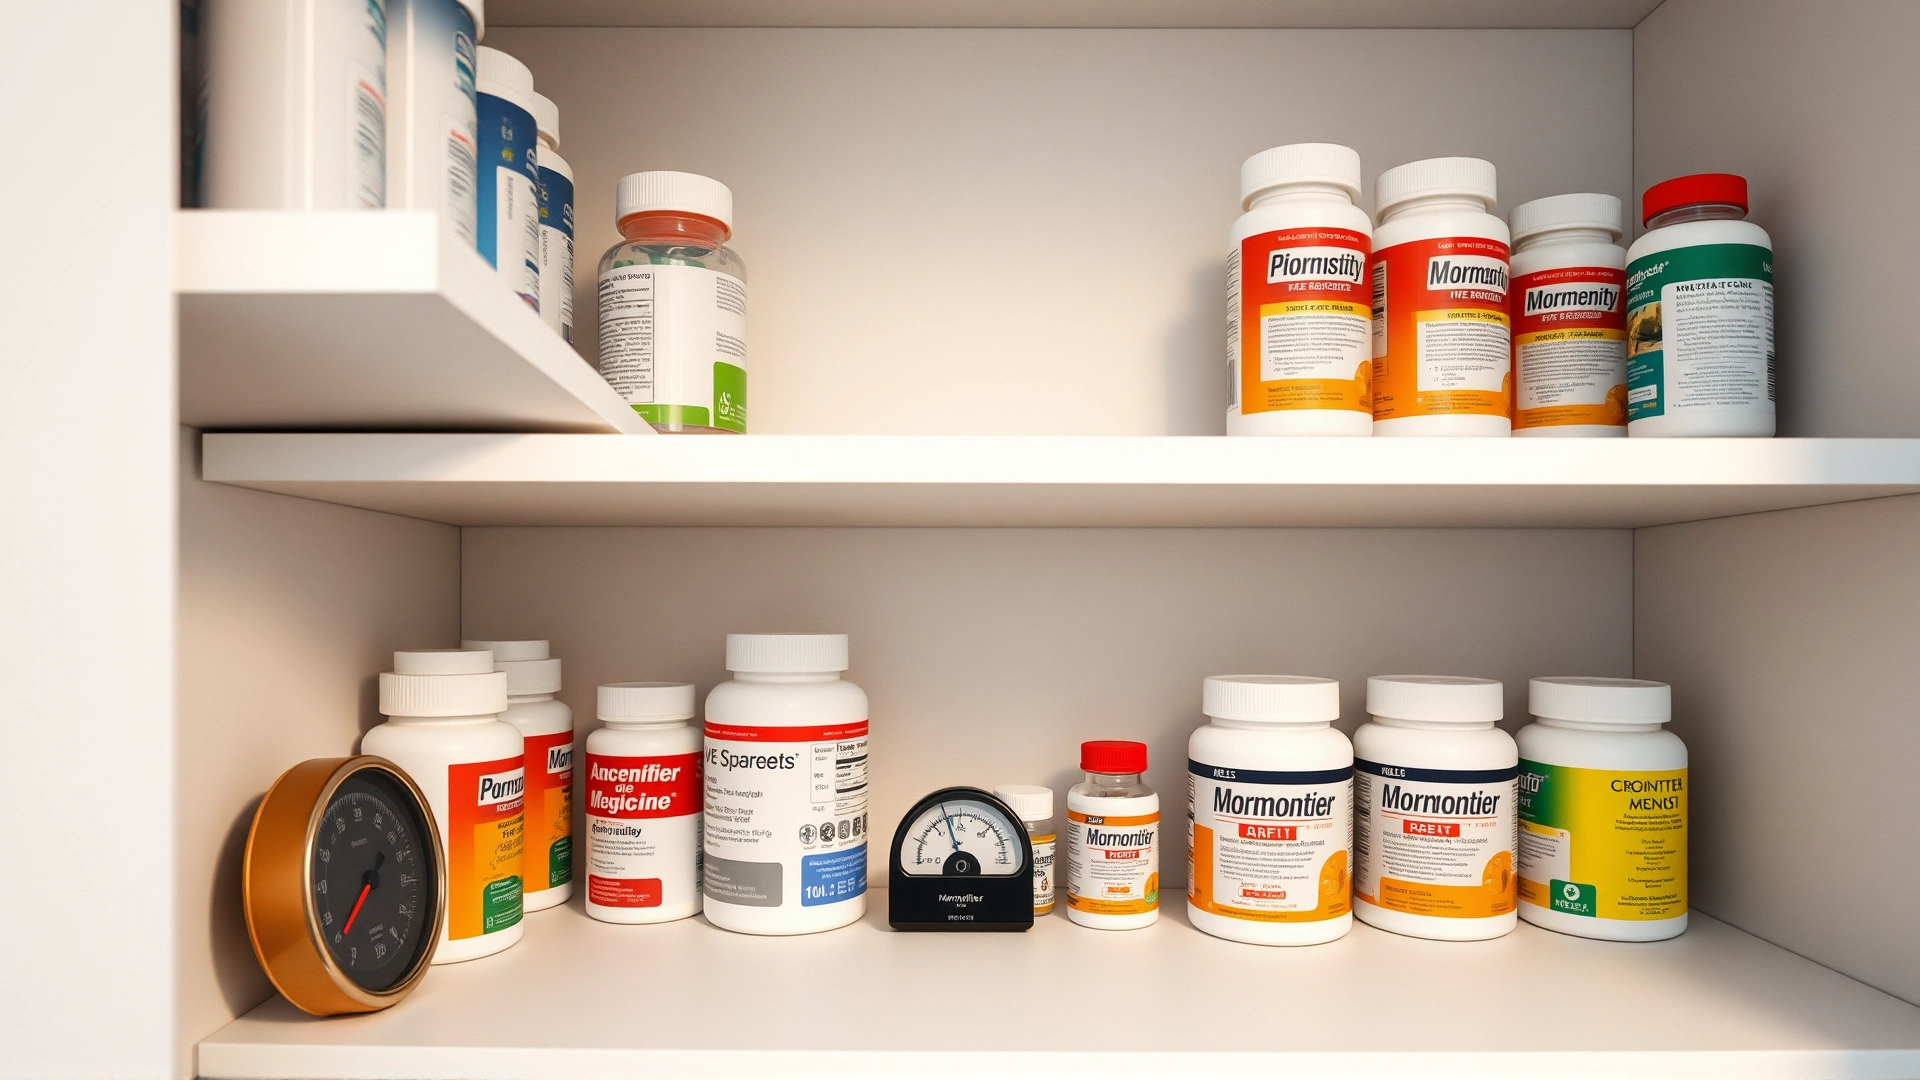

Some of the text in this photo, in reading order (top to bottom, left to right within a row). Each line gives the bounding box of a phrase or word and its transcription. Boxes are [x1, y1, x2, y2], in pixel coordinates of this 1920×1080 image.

[1527, 287, 1618, 312] Mormenity
[1213, 786, 1336, 818] Mormontier
[1381, 783, 1501, 815] Mormontier
